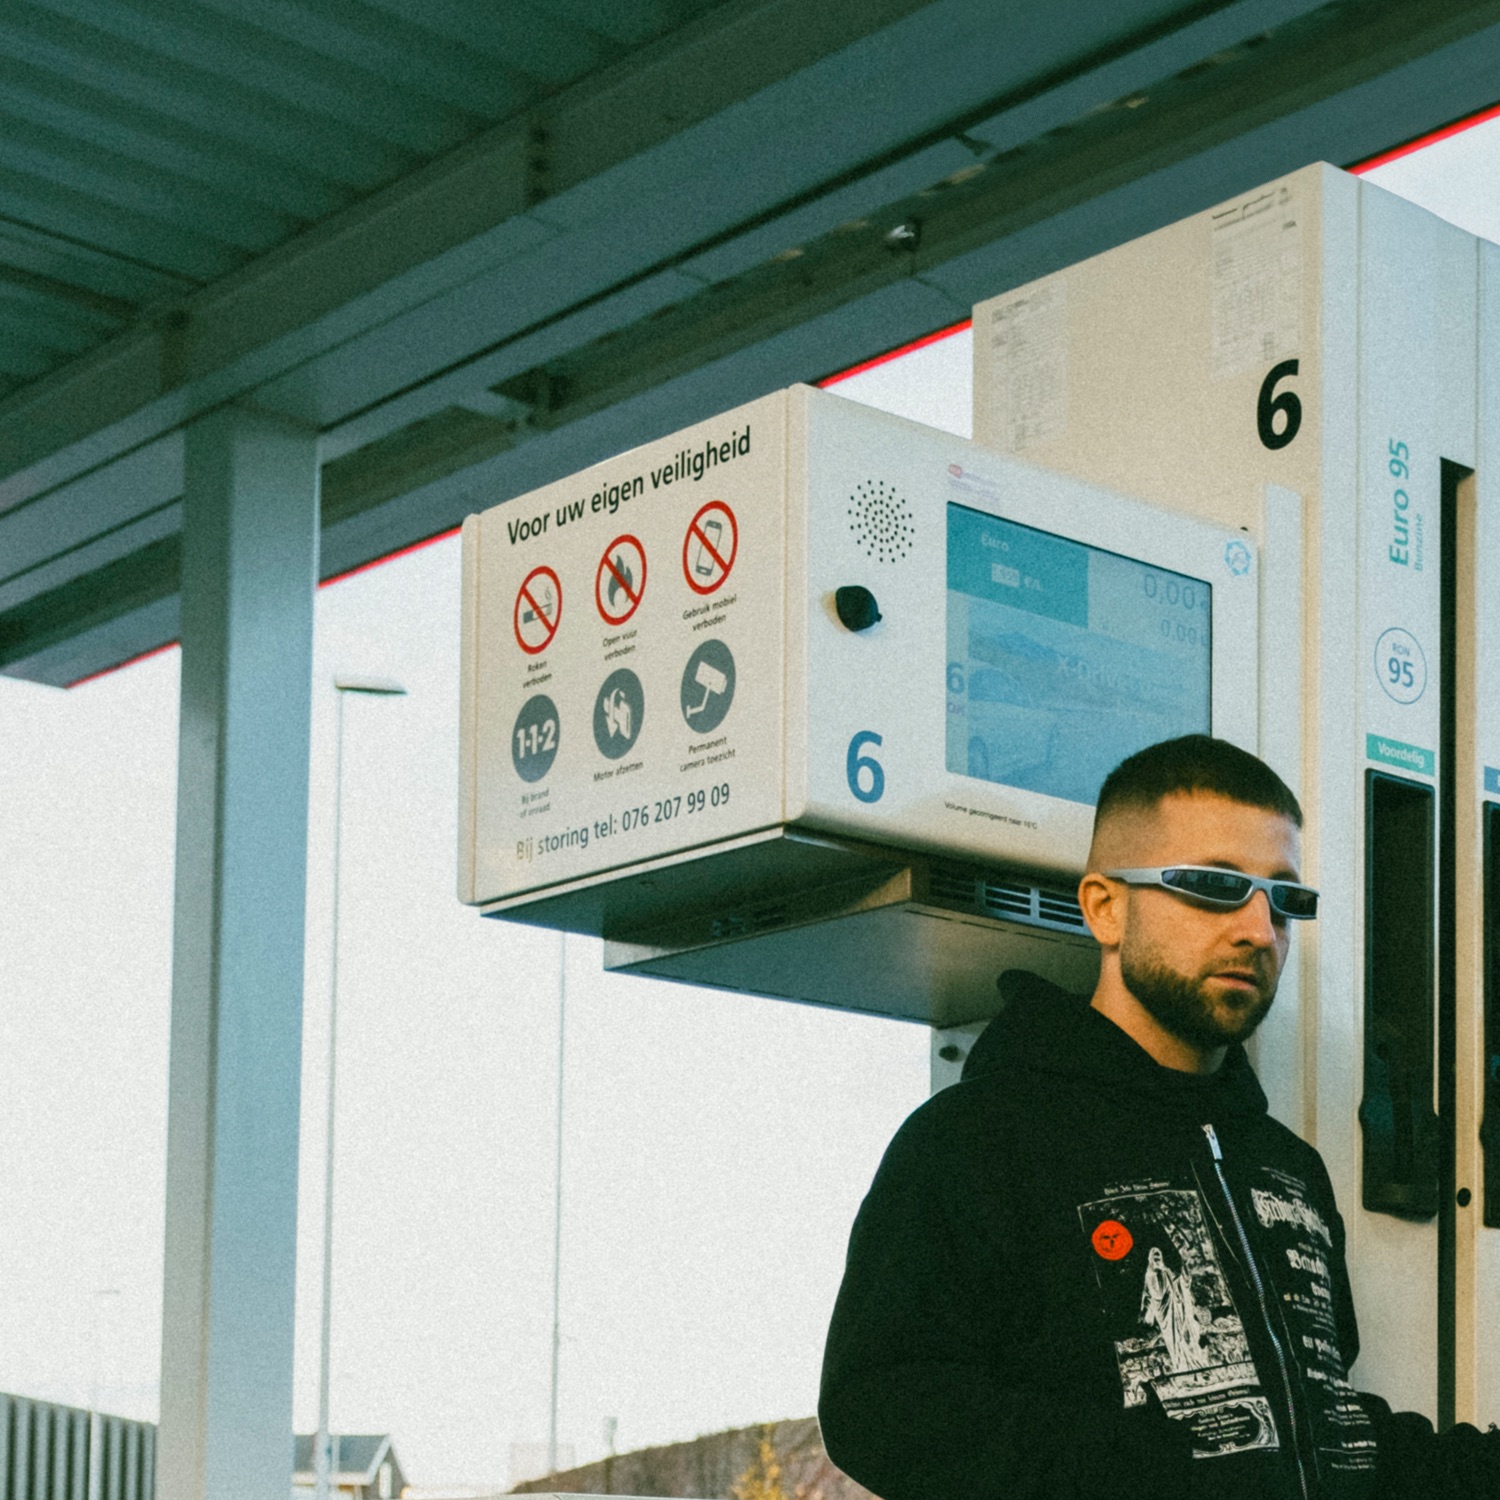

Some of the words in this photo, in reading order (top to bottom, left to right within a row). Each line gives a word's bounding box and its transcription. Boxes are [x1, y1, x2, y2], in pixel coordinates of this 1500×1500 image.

[1257, 359, 1301, 450] 6
[1389, 438, 1409, 480] 95
[507, 513, 550, 545] Voor
[556, 499, 585, 527] uw
[591, 475, 644, 514] eigen
[650, 425, 750, 489] veiligheid
[1389, 488, 1409, 566] Euro
[682, 602, 710, 620] Gebruik
[712, 593, 737, 610] mobiel
[692, 613, 726, 632] verboden
[602, 635, 621, 649] Open
[622, 629, 638, 641] vuur
[604, 643, 636, 661] verboden
[527, 660, 547, 673] Roken
[947, 662, 964, 693] 6
[1388, 657, 1414, 688] 95
[522, 672, 552, 689] verboden
[688, 737, 727, 755] Permanent
[1378, 741, 1425, 769] Voordelig
[593, 769, 614, 782] Motor
[615, 761, 644, 777] afzetten
[679, 758, 705, 772] camera
[706, 749, 736, 766] toezicht
[846, 730, 885, 804] 6
[516, 837, 533, 862] Bij
[538, 826, 588, 855] storing
[593, 814, 618, 839] tel:
[622, 806, 649, 832] 076
[654, 796, 681, 823] 207
[687, 789, 706, 814] 99
[711, 783, 730, 805] 09
